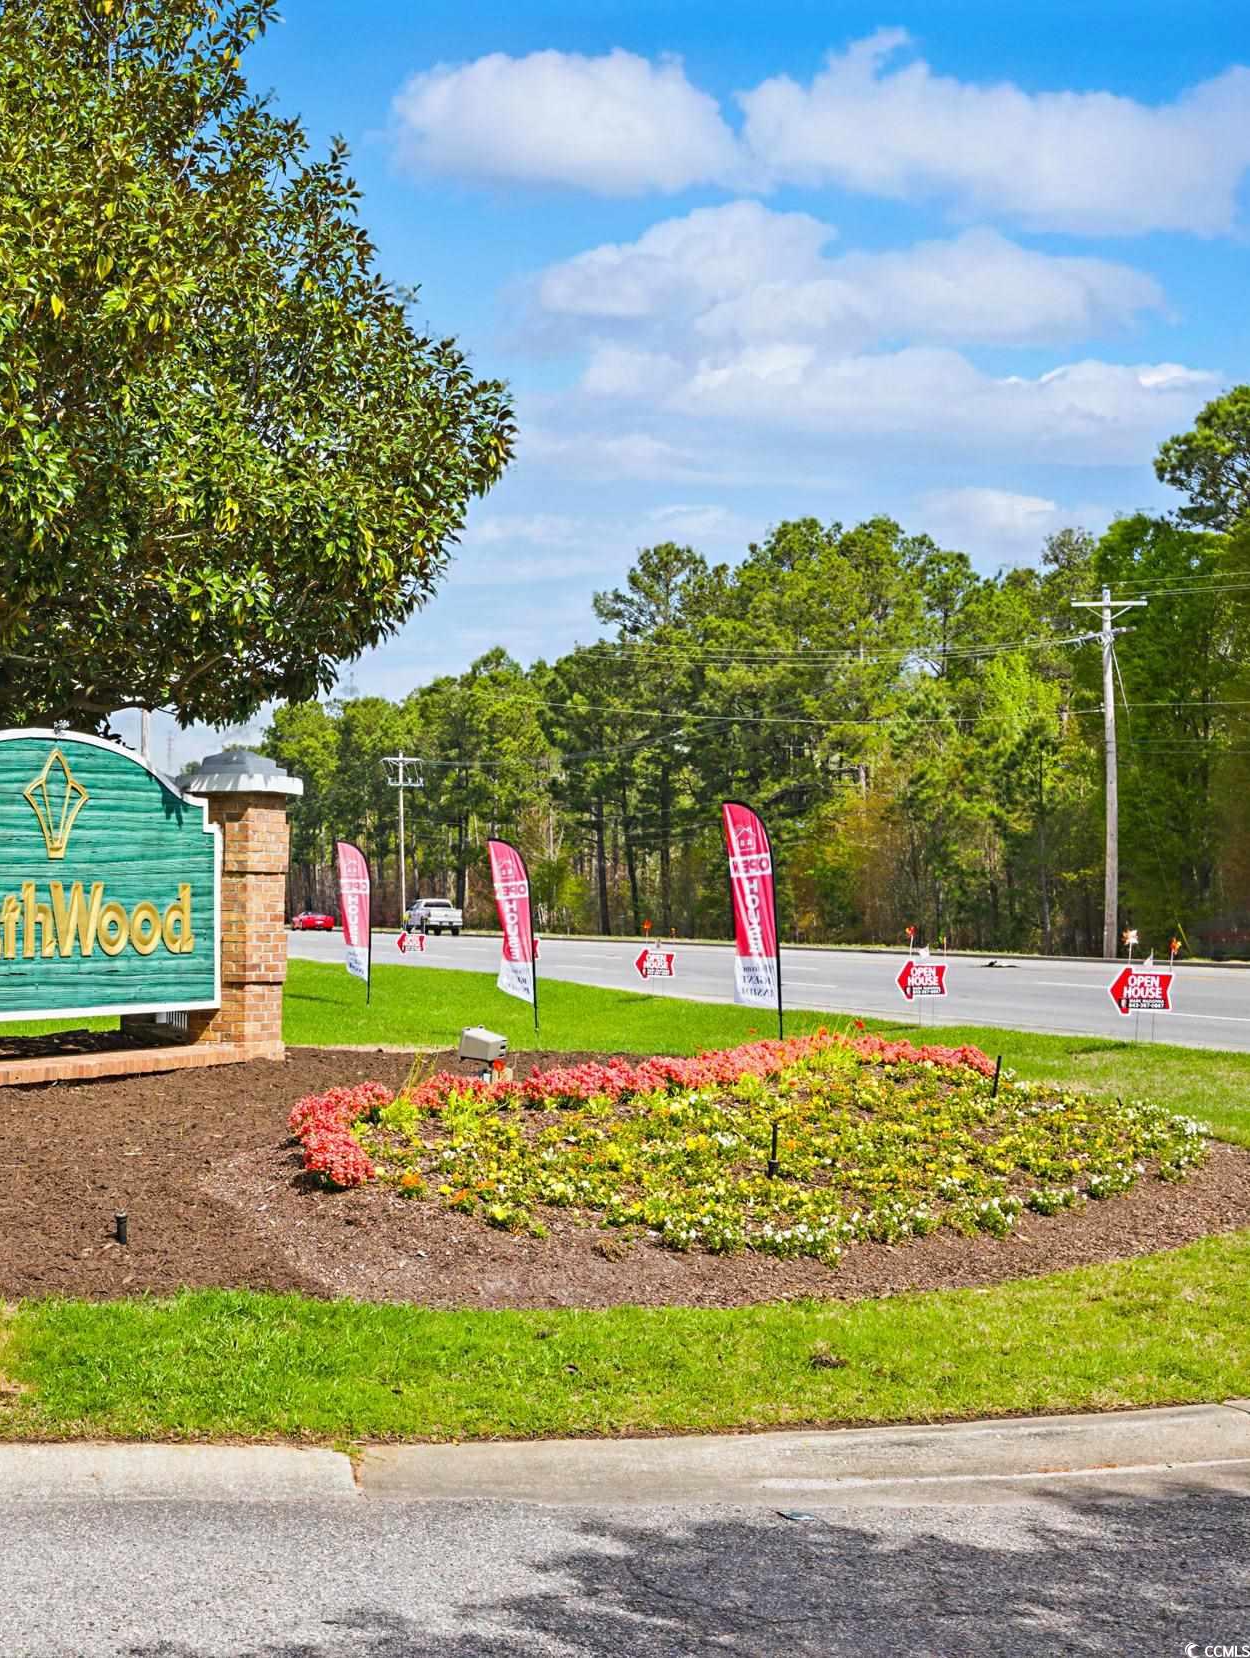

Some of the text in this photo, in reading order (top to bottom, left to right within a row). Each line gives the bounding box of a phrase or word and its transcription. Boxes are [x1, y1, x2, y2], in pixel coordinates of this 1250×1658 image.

[910, 967, 936, 977] OPEN
[907, 976, 939, 986] HOUSE
[1127, 975, 1160, 988] OPEN
[1123, 986, 1163, 998] HOUSE
